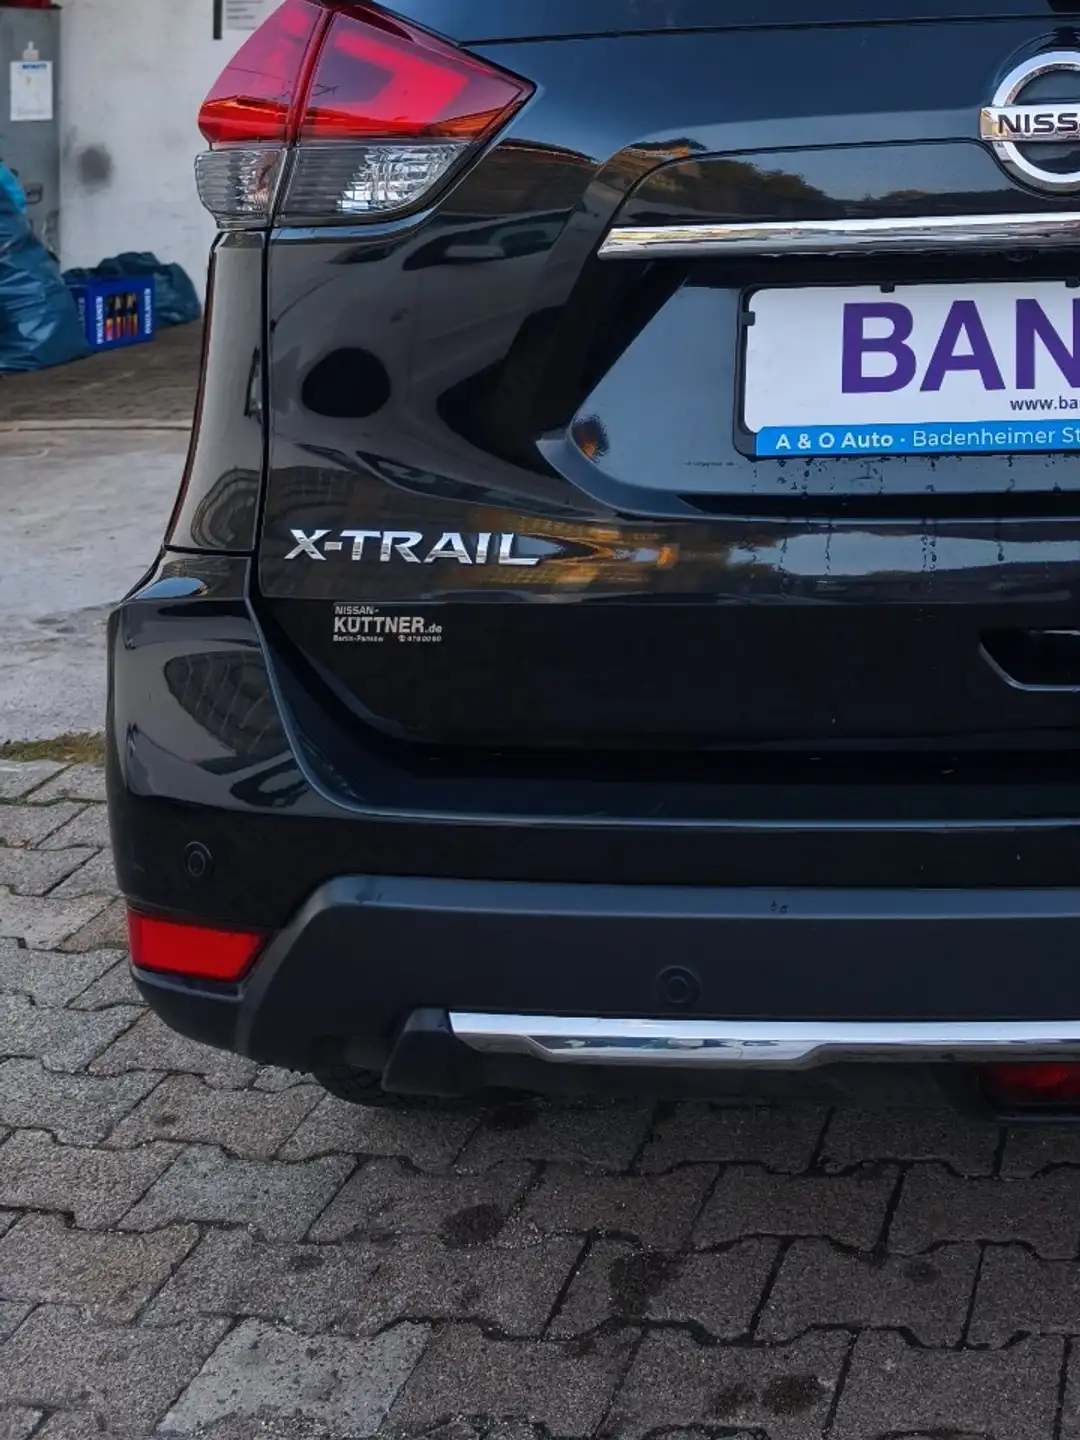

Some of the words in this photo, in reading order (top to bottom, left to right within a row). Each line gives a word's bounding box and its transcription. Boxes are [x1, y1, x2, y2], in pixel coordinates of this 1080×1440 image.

[775, 433, 791, 449] A
[797, 433, 812, 449] &
[818, 432, 835, 448] O
[841, 431, 894, 448] Auto
[913, 427, 1057, 447] Badenheimer
[284, 529, 541, 566] X-TRAIL
[335, 605, 380, 615] NISSAN-
